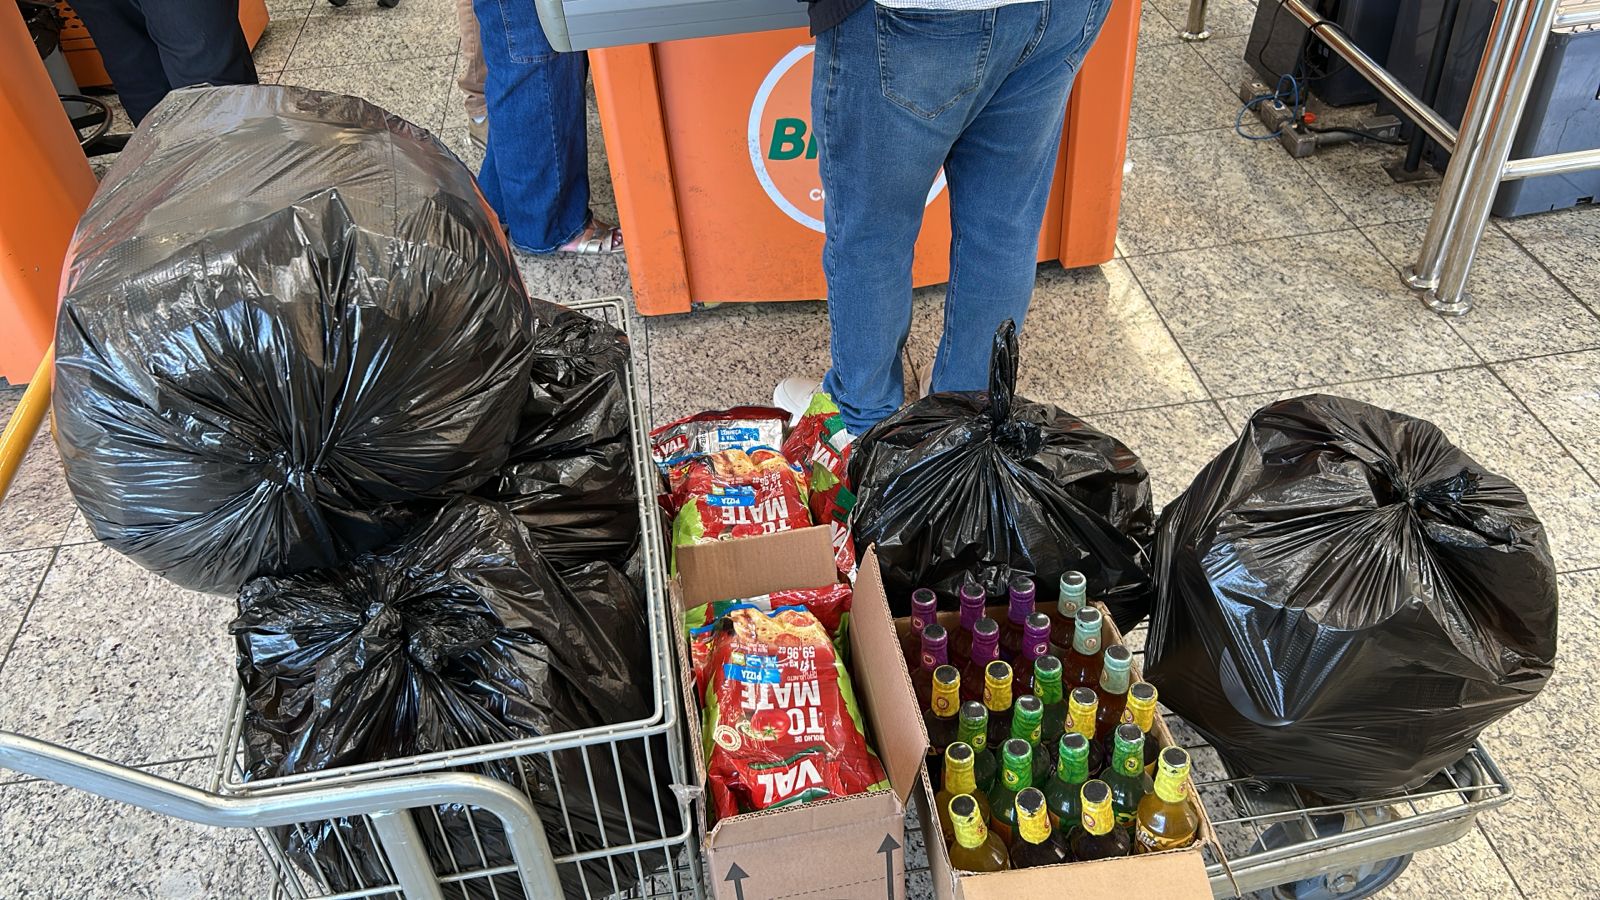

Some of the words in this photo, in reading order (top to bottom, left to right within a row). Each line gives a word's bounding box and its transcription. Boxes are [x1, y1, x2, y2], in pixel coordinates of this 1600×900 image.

[660, 437, 686, 456] VAL
[721, 497, 740, 505] PIZZA
[722, 496, 790, 525] MATE
[787, 646, 816, 659] 59,96
[741, 669, 763, 682] PIZZA
[740, 680, 821, 711] MATE
[787, 706, 825, 736] TO
[794, 735, 804, 744] DE
[804, 734, 826, 743] MOLHO
[757, 759, 824, 804] VAL
